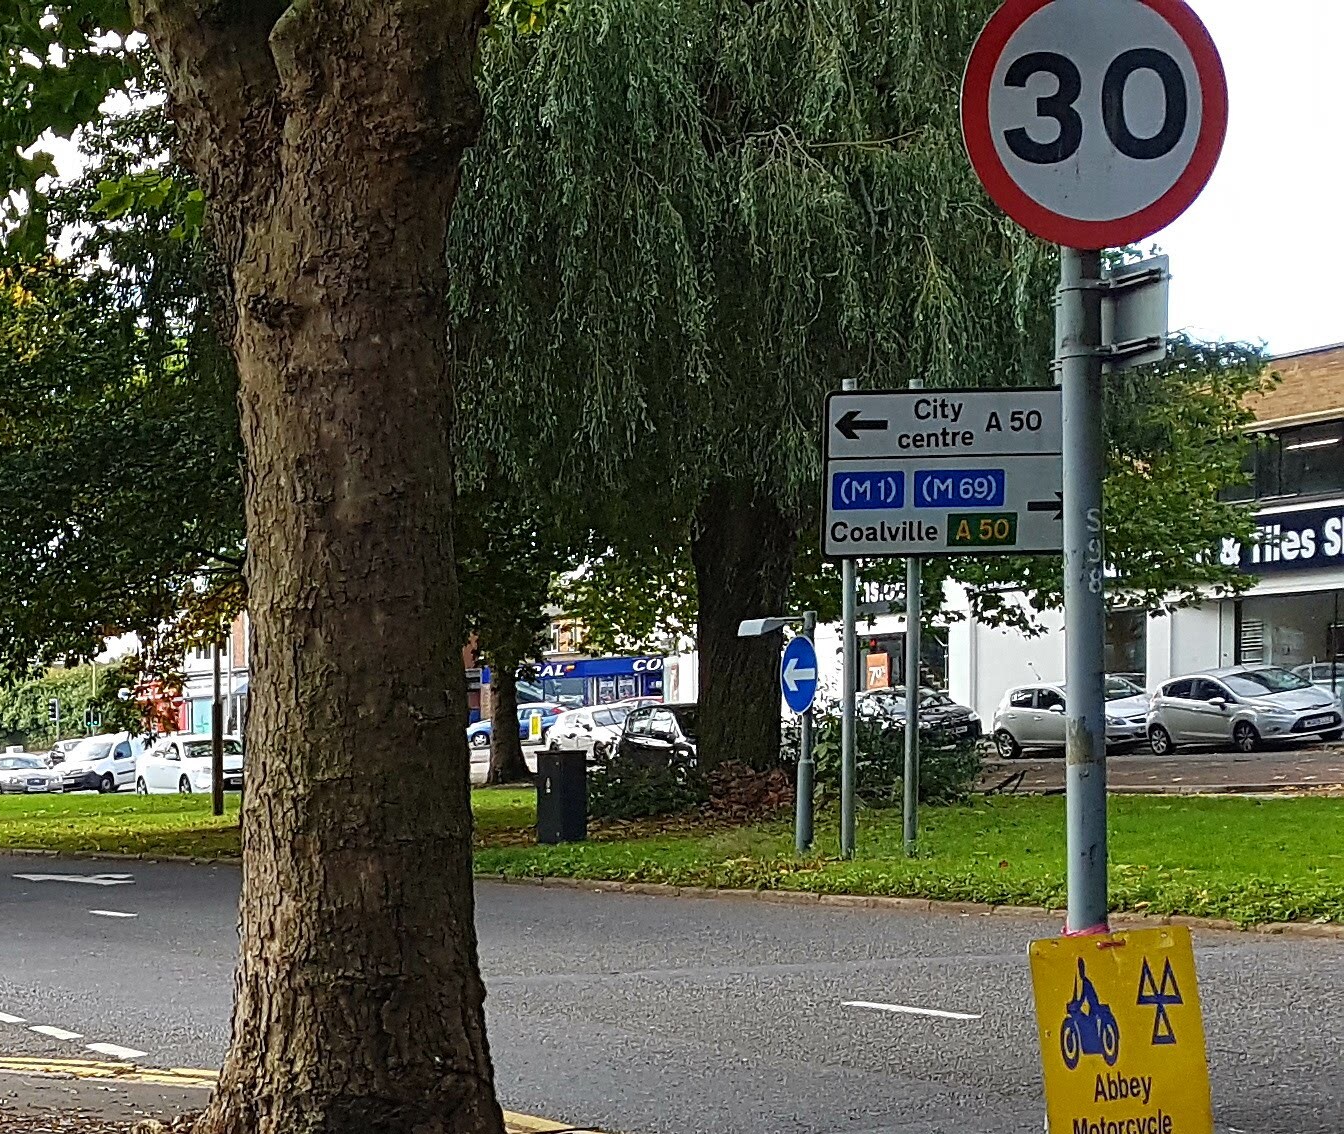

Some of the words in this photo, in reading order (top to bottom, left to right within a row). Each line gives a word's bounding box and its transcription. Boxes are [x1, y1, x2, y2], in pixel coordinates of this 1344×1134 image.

[1003, 47, 1188, 165] 30
[914, 398, 963, 422] City
[985, 411, 1002, 432] A
[1010, 410, 1042, 431] 50
[898, 427, 974, 449] centre
[830, 521, 938, 543] Coalville
[956, 521, 971, 541] A
[980, 519, 1009, 540] 50
[1094, 1071, 1152, 1105] Abbey
